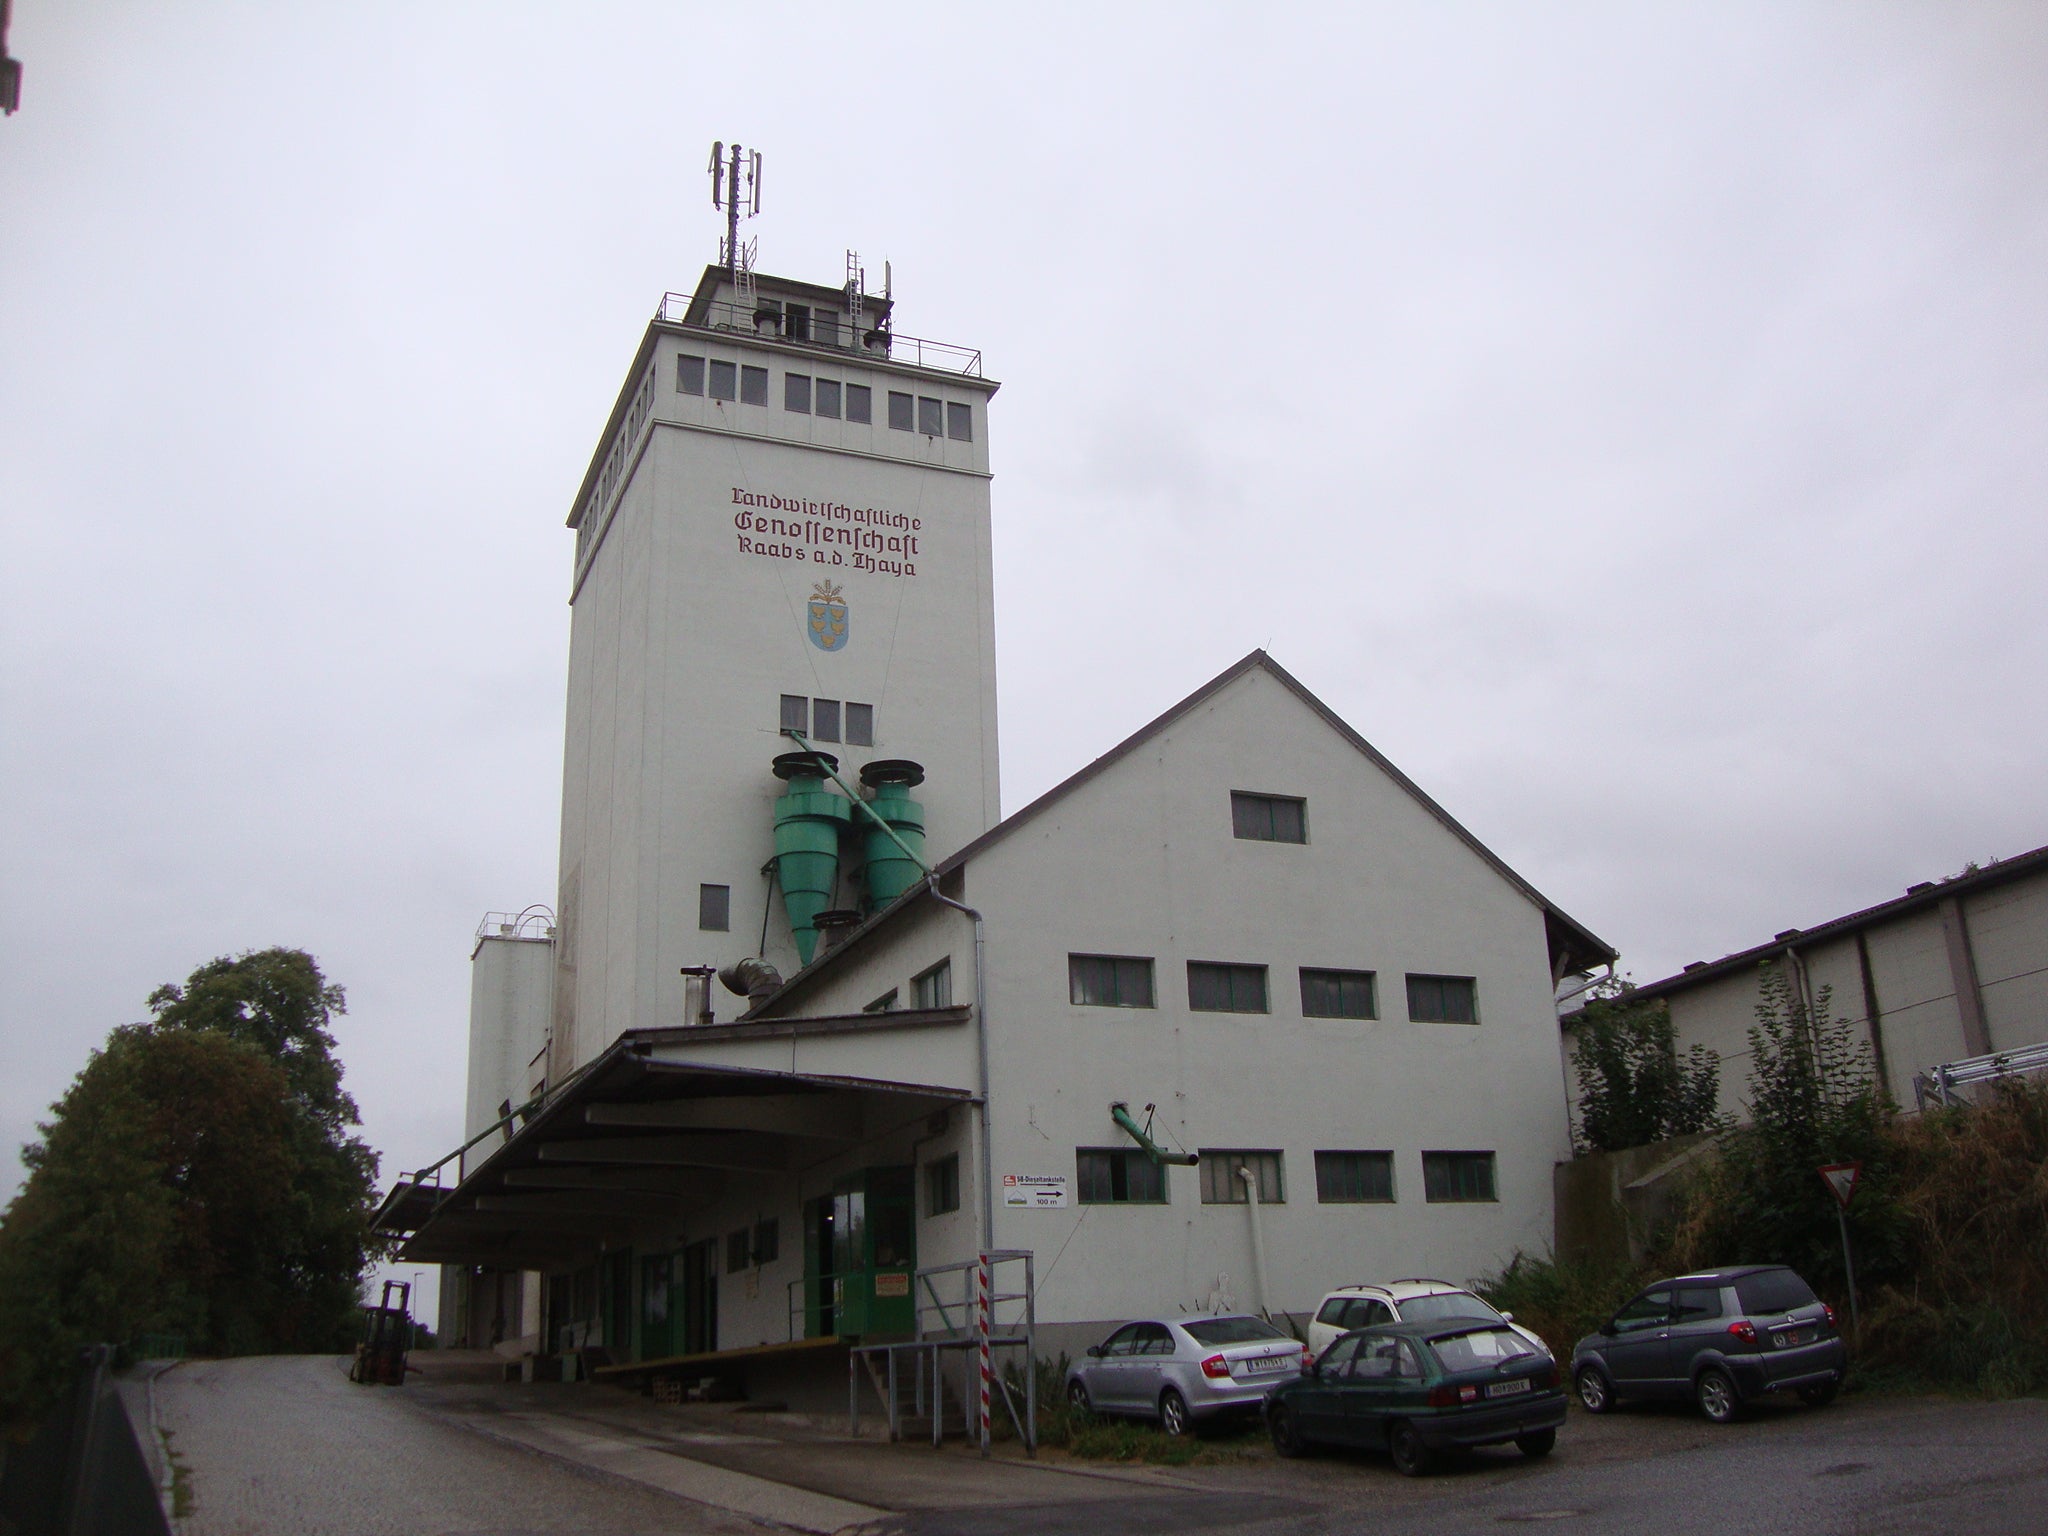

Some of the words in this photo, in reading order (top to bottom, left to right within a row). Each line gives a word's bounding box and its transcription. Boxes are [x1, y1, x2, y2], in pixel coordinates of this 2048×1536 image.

[731, 487, 922, 532] Landwirtschaftliche
[734, 511, 919, 560] Genossenschaft
[737, 533, 806, 560] Raabs
[852, 552, 917, 577] Thaya
